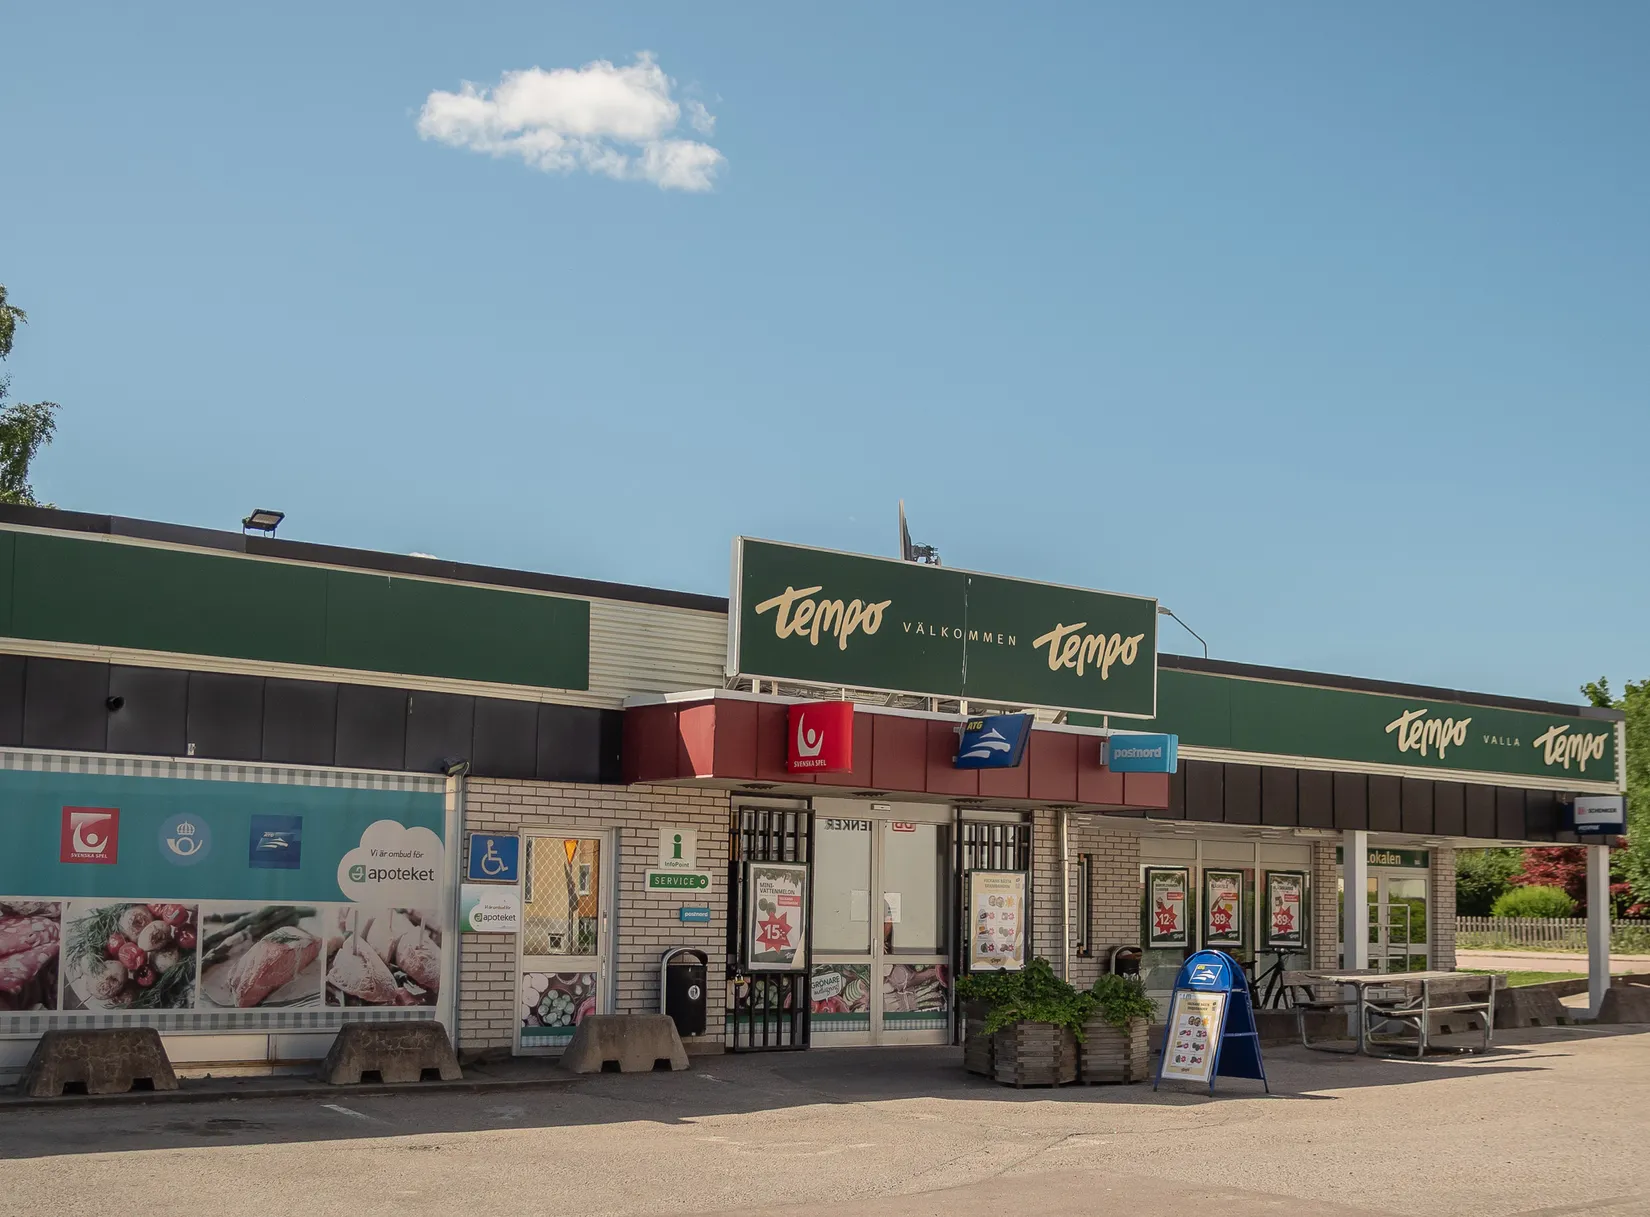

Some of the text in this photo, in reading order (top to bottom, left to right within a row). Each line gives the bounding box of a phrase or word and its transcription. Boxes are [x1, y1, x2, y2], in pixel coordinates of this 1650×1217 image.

[903, 620, 1017, 646] VÄLKOMMEN
[967, 721, 983, 730] ATG
[1483, 734, 1520, 747] VALLA
[1114, 746, 1161, 760] postnord
[370, 849, 424, 859] Vi är ombud för
[1367, 850, 1401, 865] okalen
[368, 867, 434, 883] apoteket
[654, 876, 695, 886] SERVICE
[483, 913, 517, 922] apoteket
